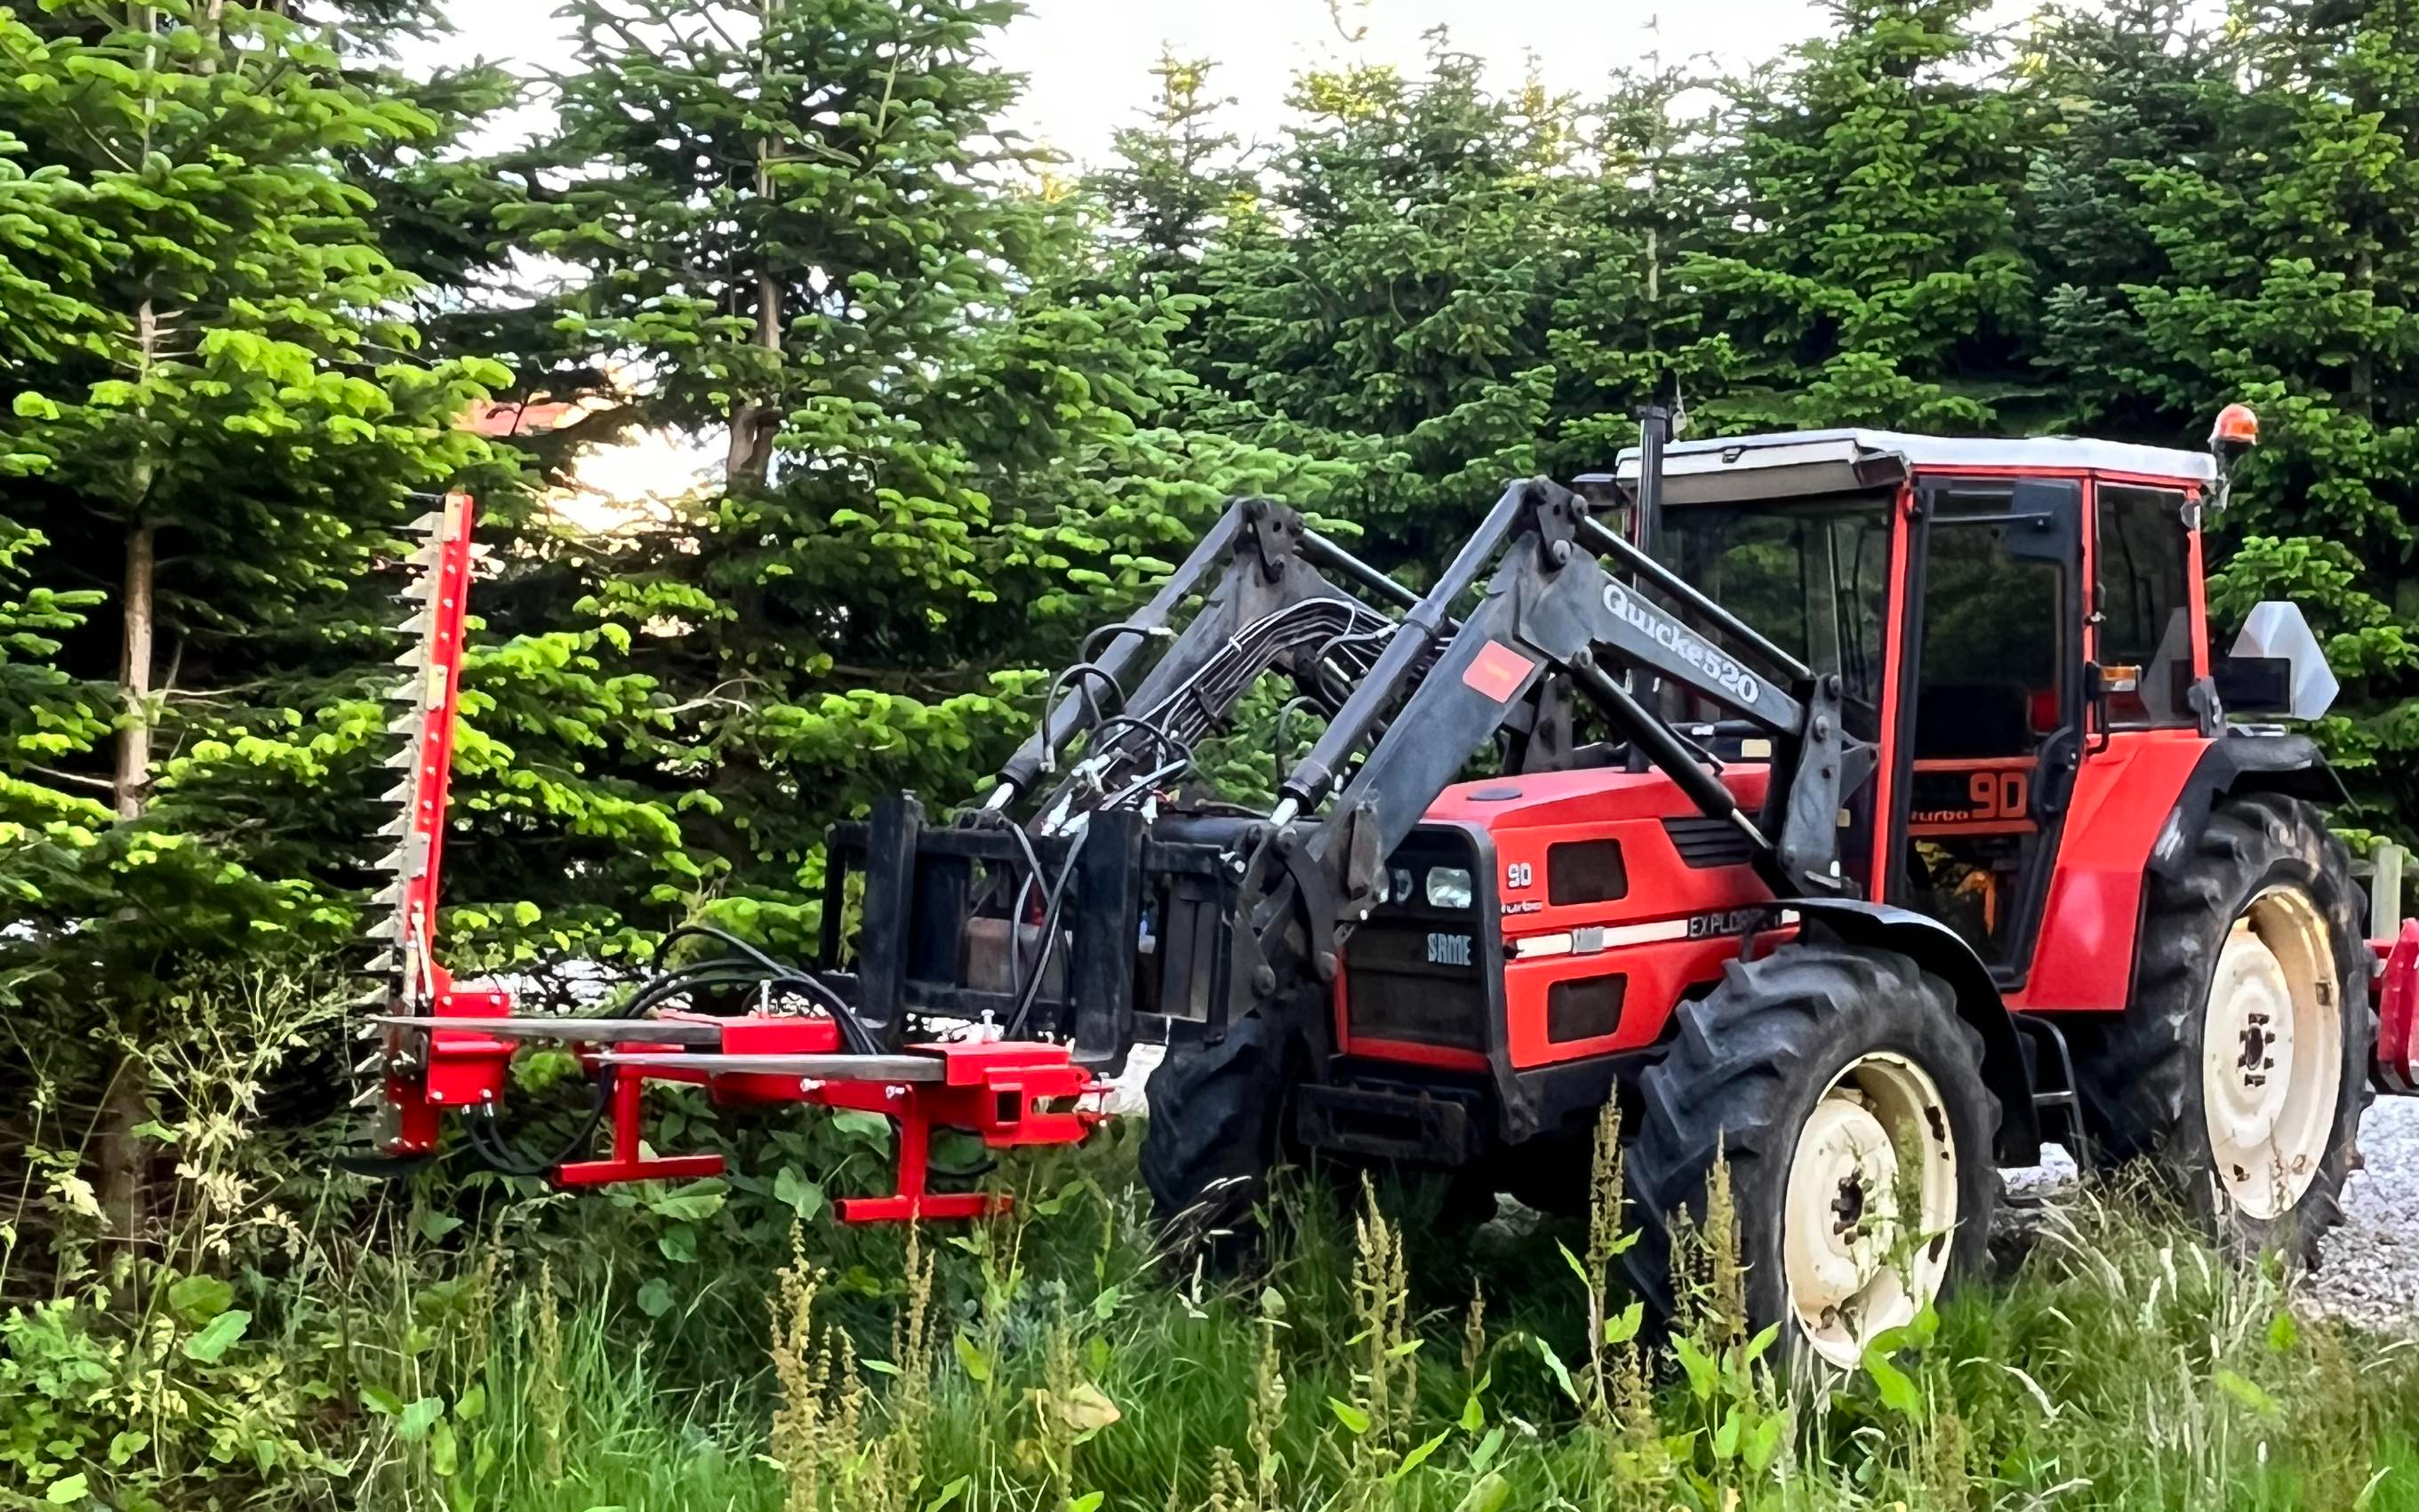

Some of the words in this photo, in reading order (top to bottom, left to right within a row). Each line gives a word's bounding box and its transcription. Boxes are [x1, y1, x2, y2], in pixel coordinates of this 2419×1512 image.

[1970, 772, 2027, 818] 90
[1508, 862, 1532, 887] 90
[1427, 933, 1471, 965] SAME
